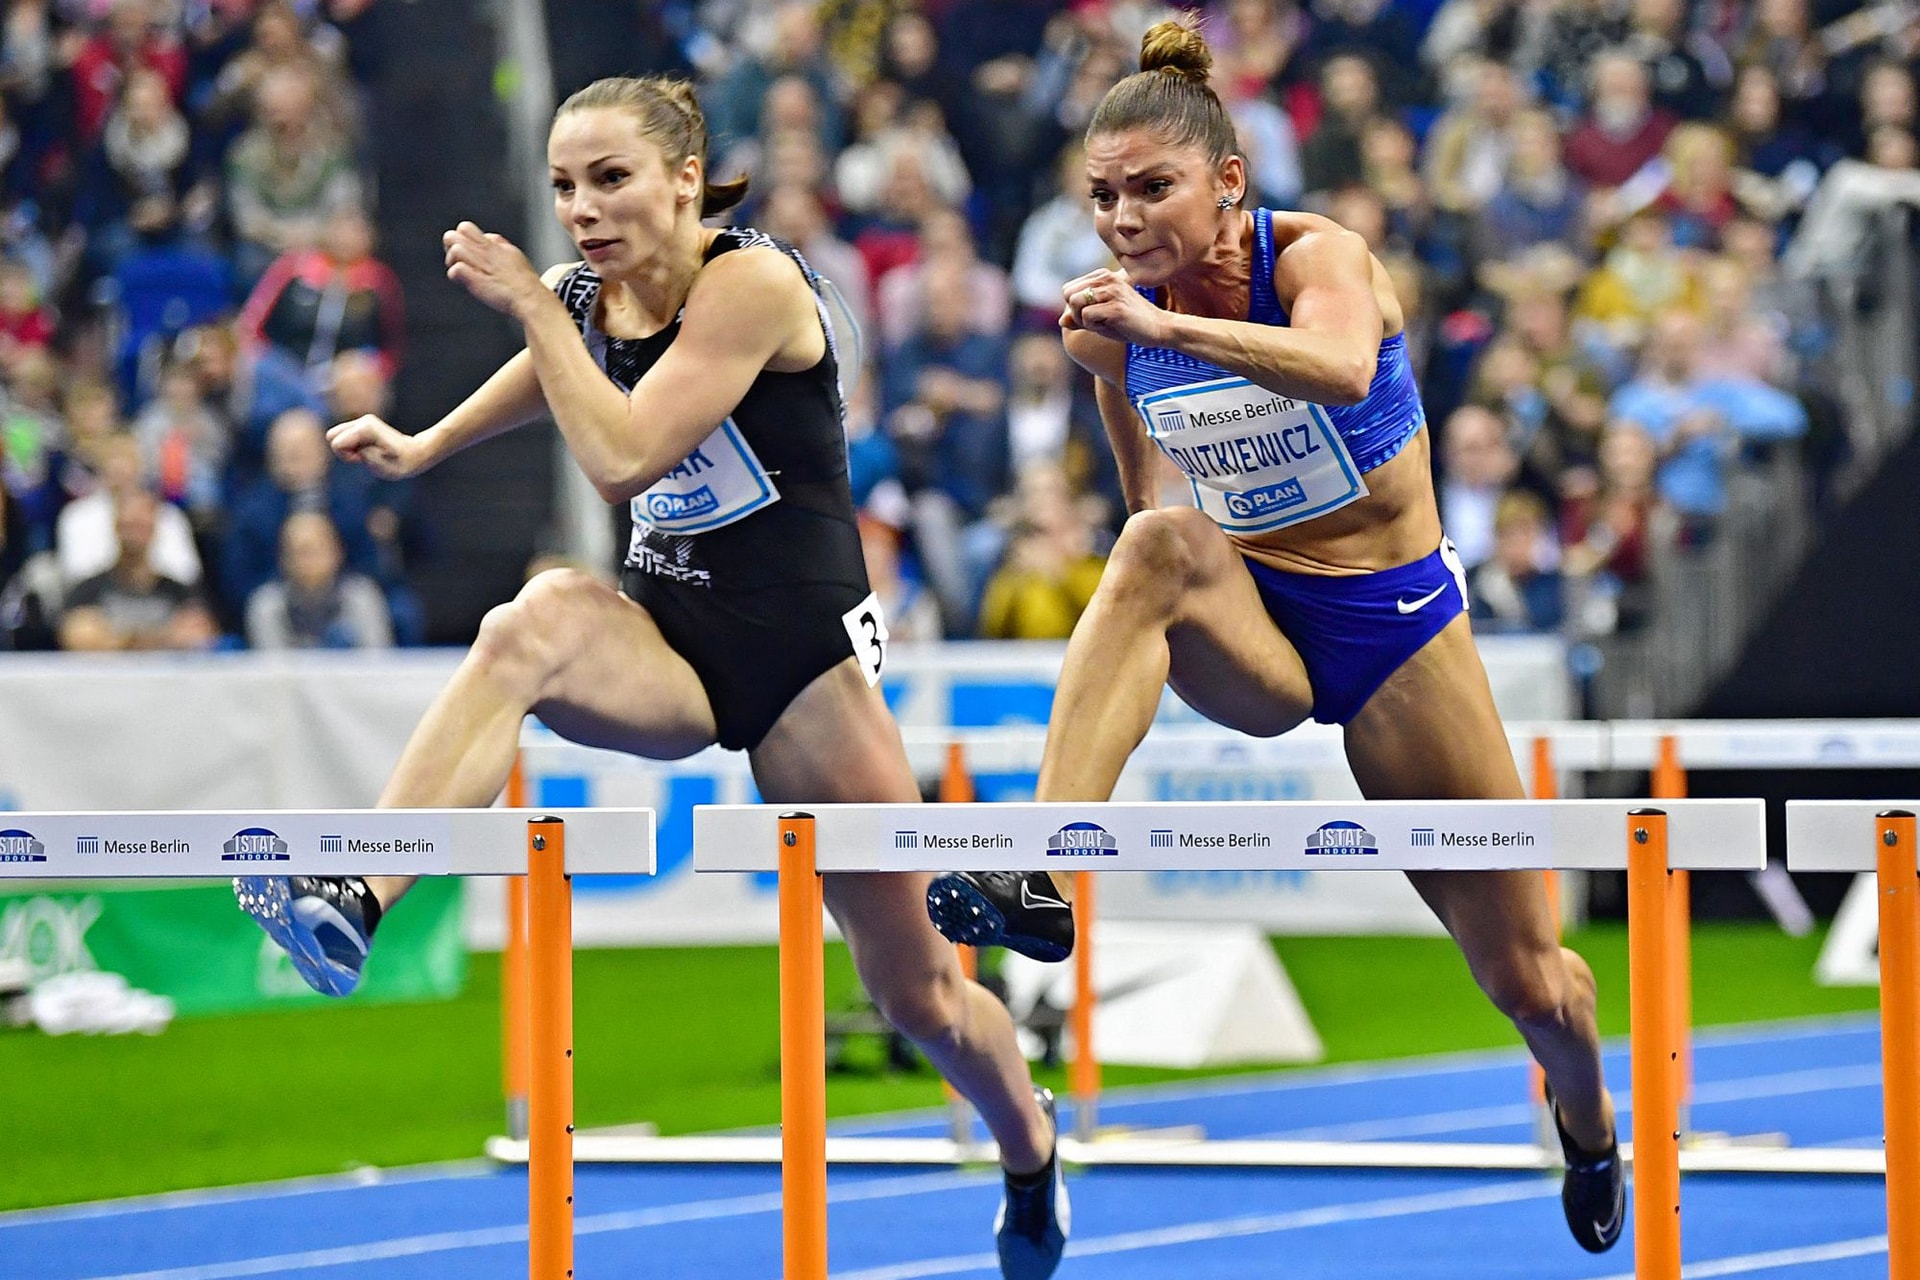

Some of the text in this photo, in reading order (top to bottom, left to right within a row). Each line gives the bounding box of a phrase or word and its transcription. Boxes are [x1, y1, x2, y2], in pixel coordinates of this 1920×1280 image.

[1189, 397, 1295, 428] Messe Berlin
[1169, 423, 1321, 479] DUTKIEWICZ
[672, 491, 712, 512] PLAN
[1252, 484, 1300, 507] PLAN
[859, 611, 882, 674] 3
[0, 836, 33, 853] STAF
[104, 838, 190, 854] Messe Berlin
[234, 835, 276, 852] ISTAF
[347, 838, 434, 853] Messe Berlin
[924, 834, 1013, 849] Messe Berlin
[1060, 829, 1104, 848] ISTAF
[1179, 833, 1271, 848] Messe Berlin
[1319, 828, 1363, 847] ISTAF
[1441, 831, 1535, 847] Messe Berlin
[234, 852, 277, 861] INDOOR
[1059, 848, 1105, 856] INDOOR
[1318, 847, 1364, 855] INDOOR
